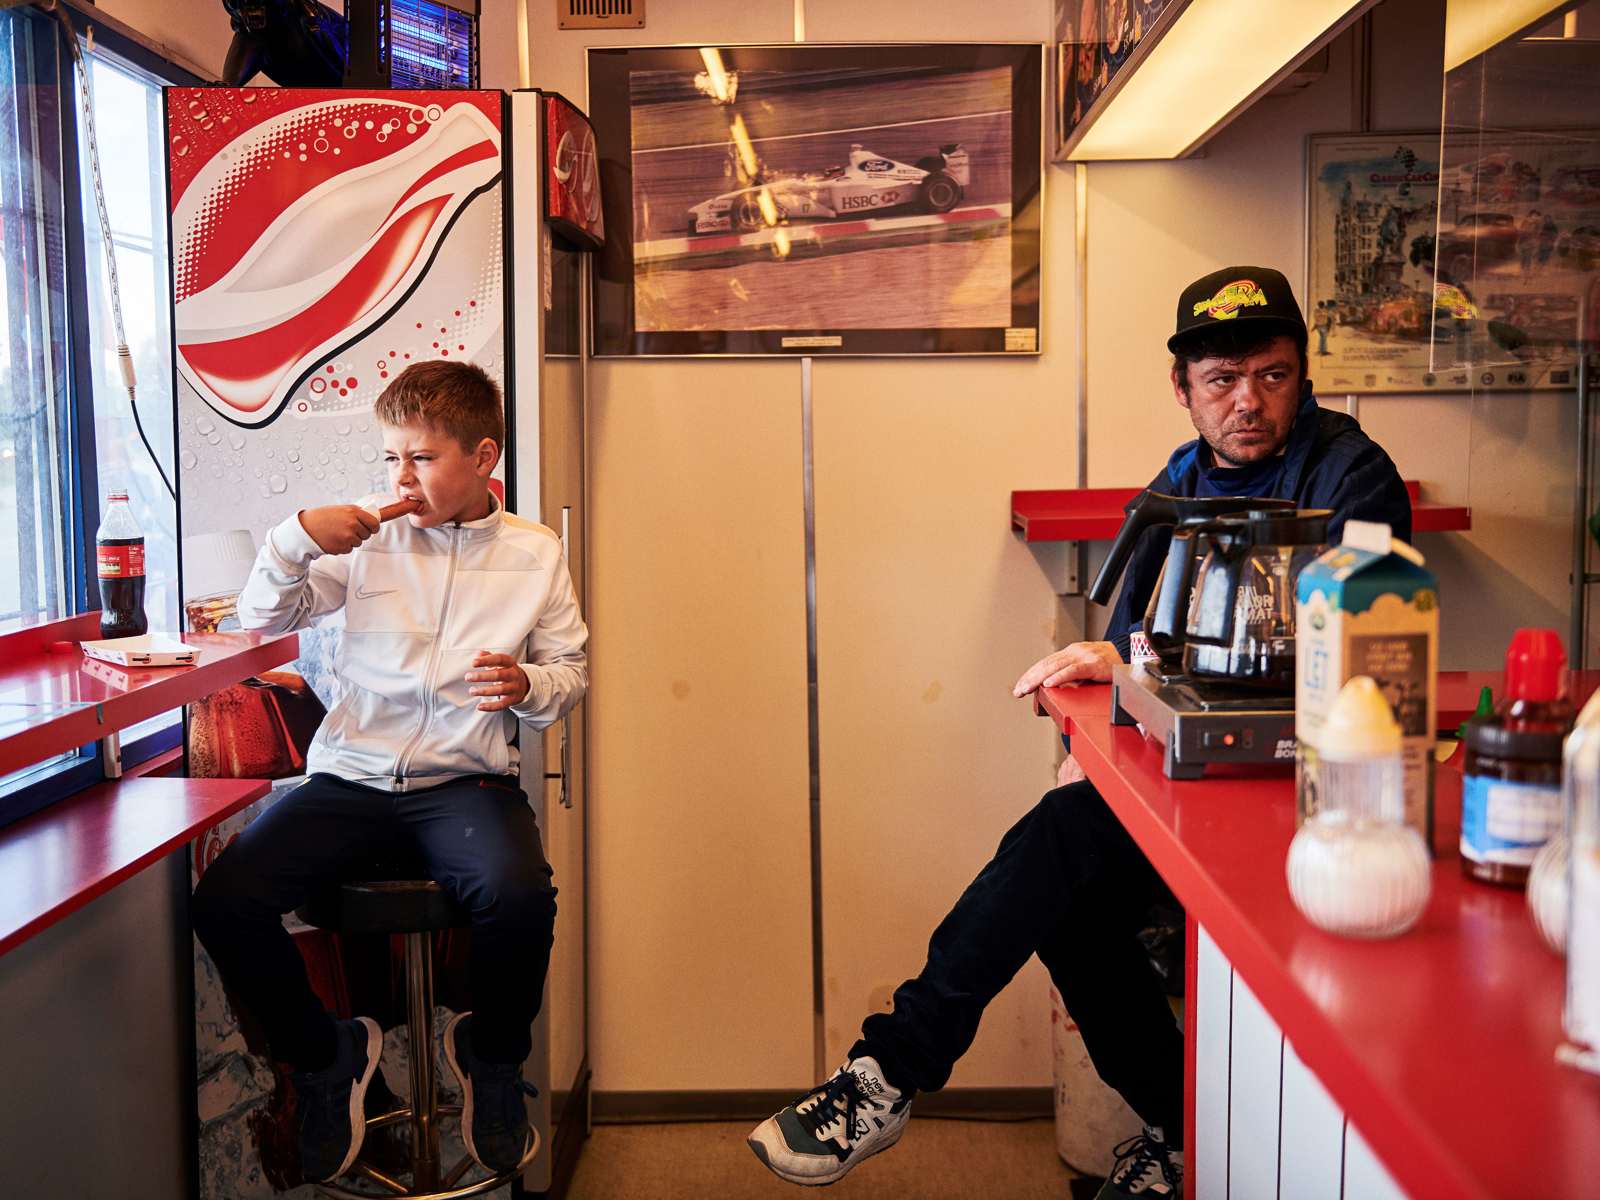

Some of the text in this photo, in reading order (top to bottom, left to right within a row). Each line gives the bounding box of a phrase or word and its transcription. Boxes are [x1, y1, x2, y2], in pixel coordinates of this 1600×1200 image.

[865, 160, 889, 171] Ford
[842, 194, 879, 210] HSBC
[870, 1076, 886, 1094] new
